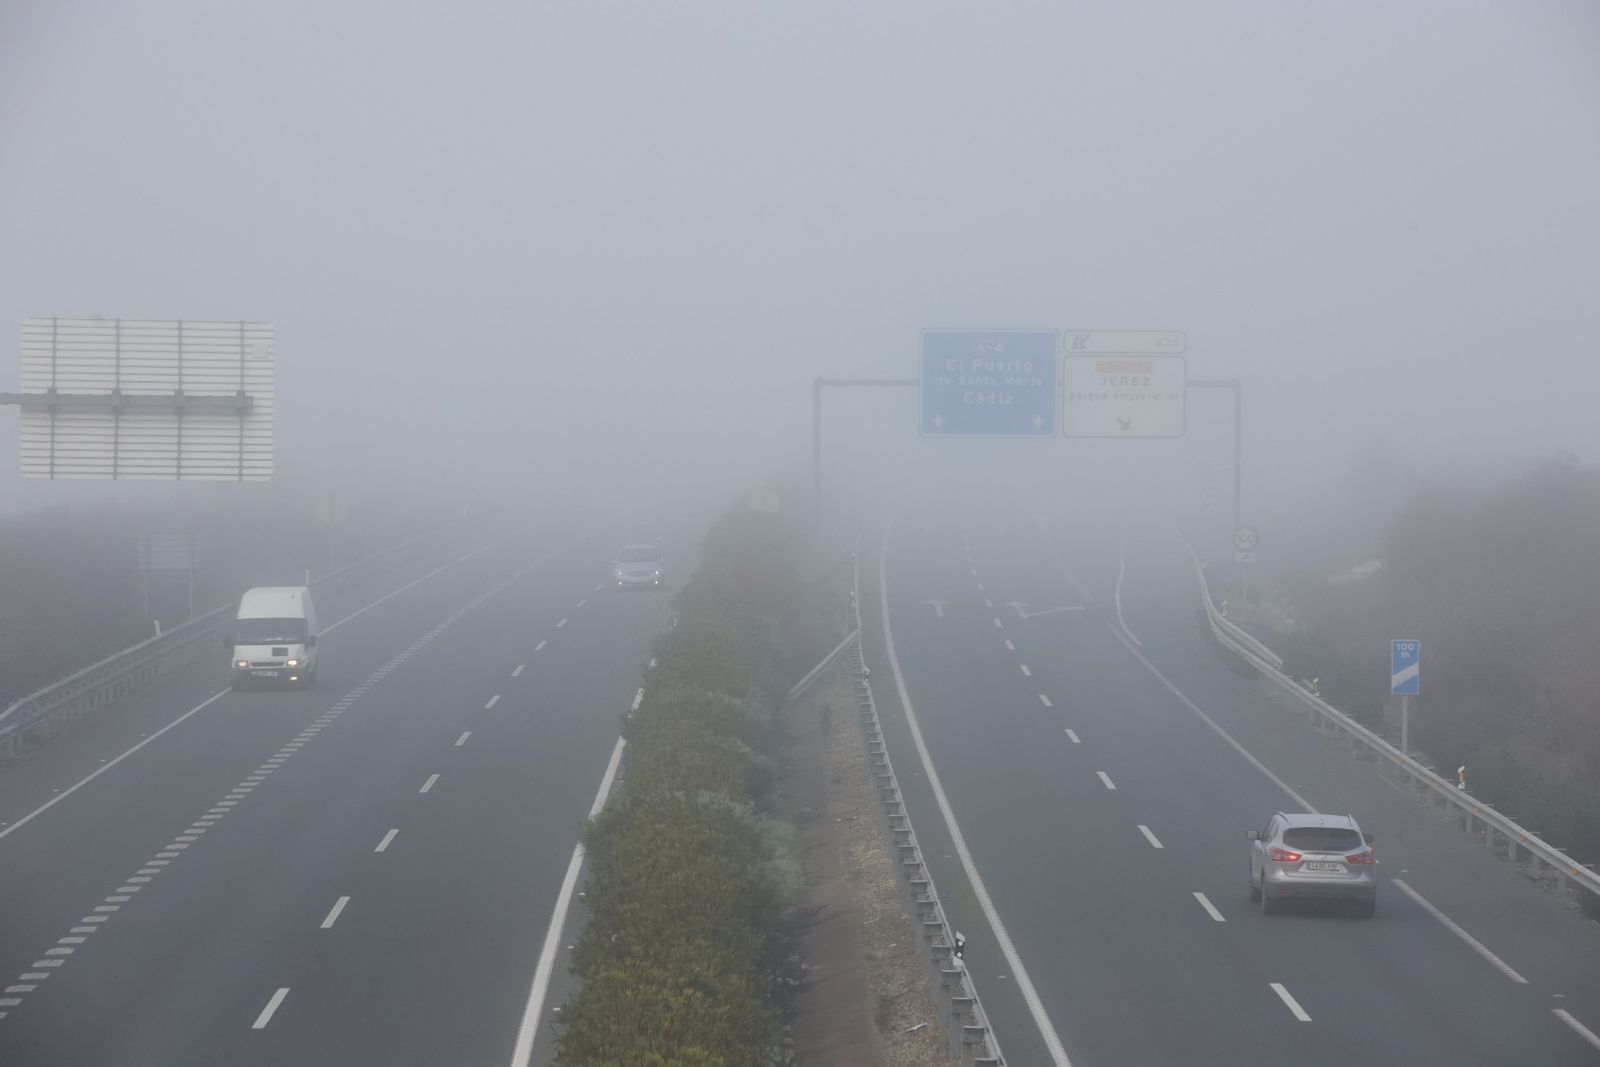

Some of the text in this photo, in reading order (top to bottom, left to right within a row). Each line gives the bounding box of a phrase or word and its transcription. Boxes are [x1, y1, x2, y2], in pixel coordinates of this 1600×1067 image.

[946, 358, 1032, 372] El Puerto
[959, 376, 997, 386] Santa
[1099, 376, 1152, 387] JEREZ
[964, 391, 1014, 405] Cádiz
[1237, 534, 1255, 543] 100
[1397, 642, 1415, 651] 100
[1400, 651, 1410, 659] m
